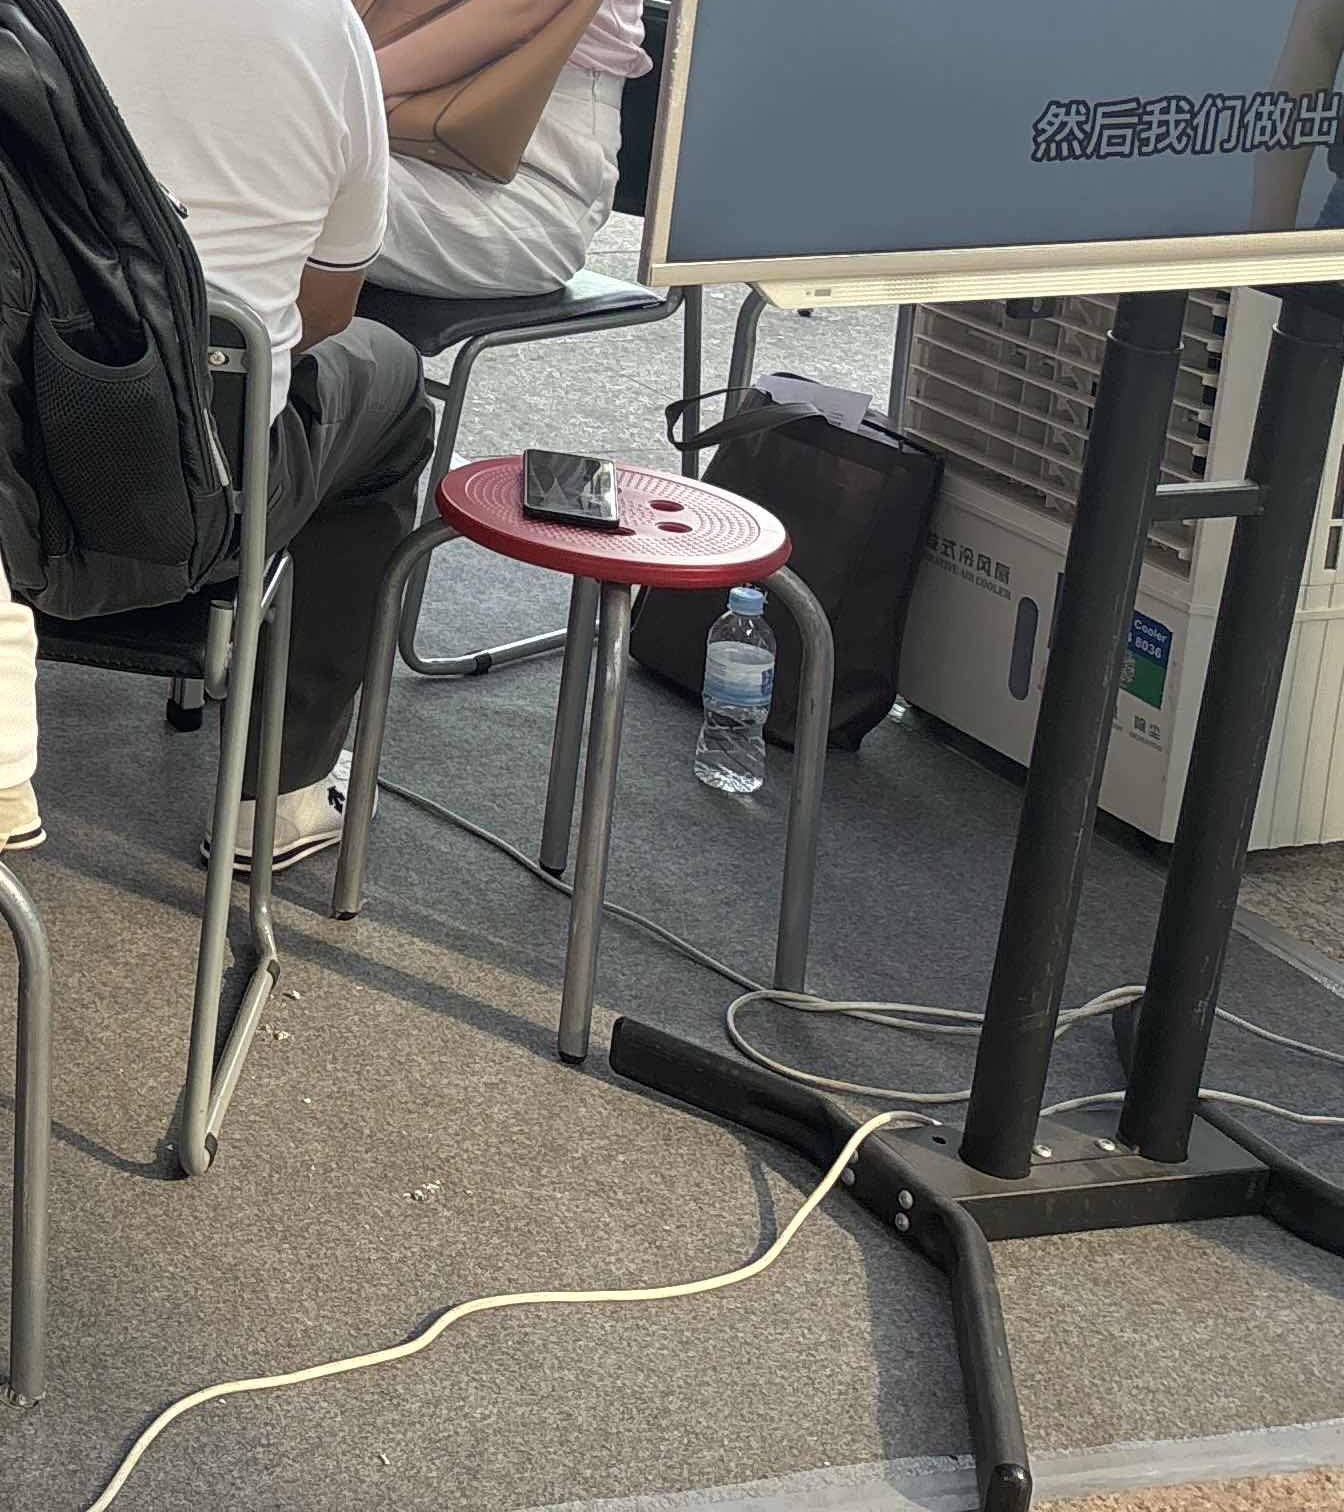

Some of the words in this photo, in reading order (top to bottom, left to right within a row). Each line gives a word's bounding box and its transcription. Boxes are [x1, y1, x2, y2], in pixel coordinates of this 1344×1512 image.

[1031, 90, 1341, 162] 然后我们做出
